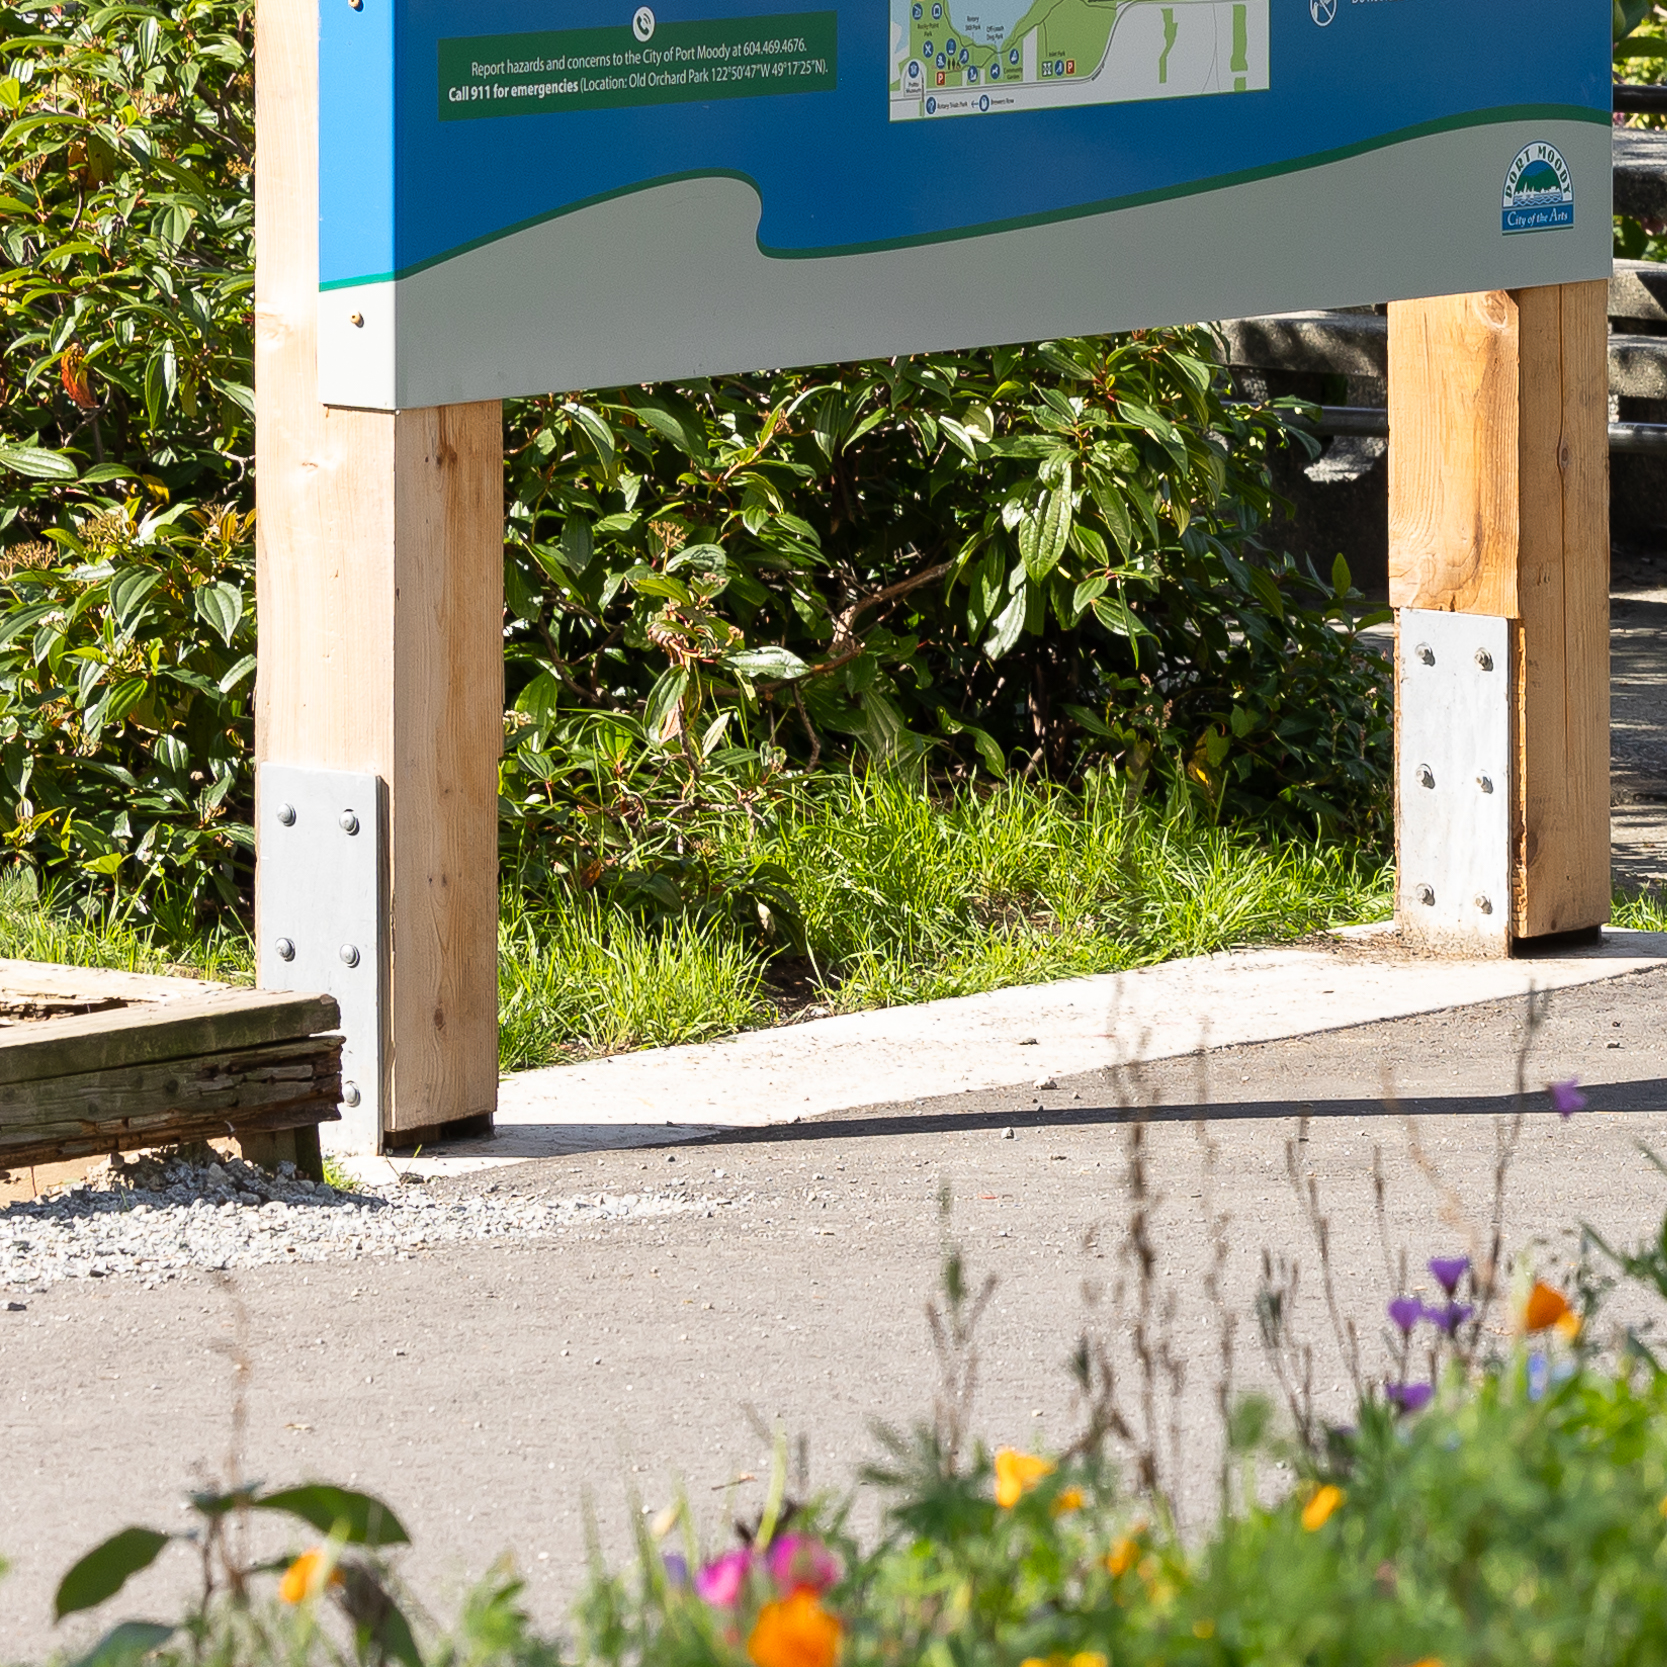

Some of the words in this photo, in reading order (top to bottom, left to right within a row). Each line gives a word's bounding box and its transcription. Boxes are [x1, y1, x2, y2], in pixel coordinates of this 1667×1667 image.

[471, 61, 505, 79] Report
[506, 56, 545, 73] hazards
[545, 54, 565, 71] and
[566, 55, 611, 69] concerns
[612, 52, 623, 66] to
[624, 49, 641, 65] the
[642, 48, 662, 67] City
[663, 46, 674, 62] of
[675, 46, 695, 61] Port
[696, 43, 731, 61] Moody
[731, 43, 741, 57] at
[743, 37, 807, 56] 604.469.4676.
[448, 85, 469, 102] Call
[470, 85, 490, 100] 911
[492, 83, 509, 98] for
[510, 78, 578, 99] emergencies
[580, 75, 627, 93] (Location:
[628, 72, 646, 88] Old
[647, 69, 686, 86] Orchard
[688, 67, 709, 83] Park
[1505, 148, 1531, 198] PORT
[1538, 145, 1571, 194] MOODY
[1507, 210, 1526, 227] City
[1527, 213, 1537, 227] of
[1537, 213, 1548, 223] the
[1549, 208, 1568, 222] Arts
